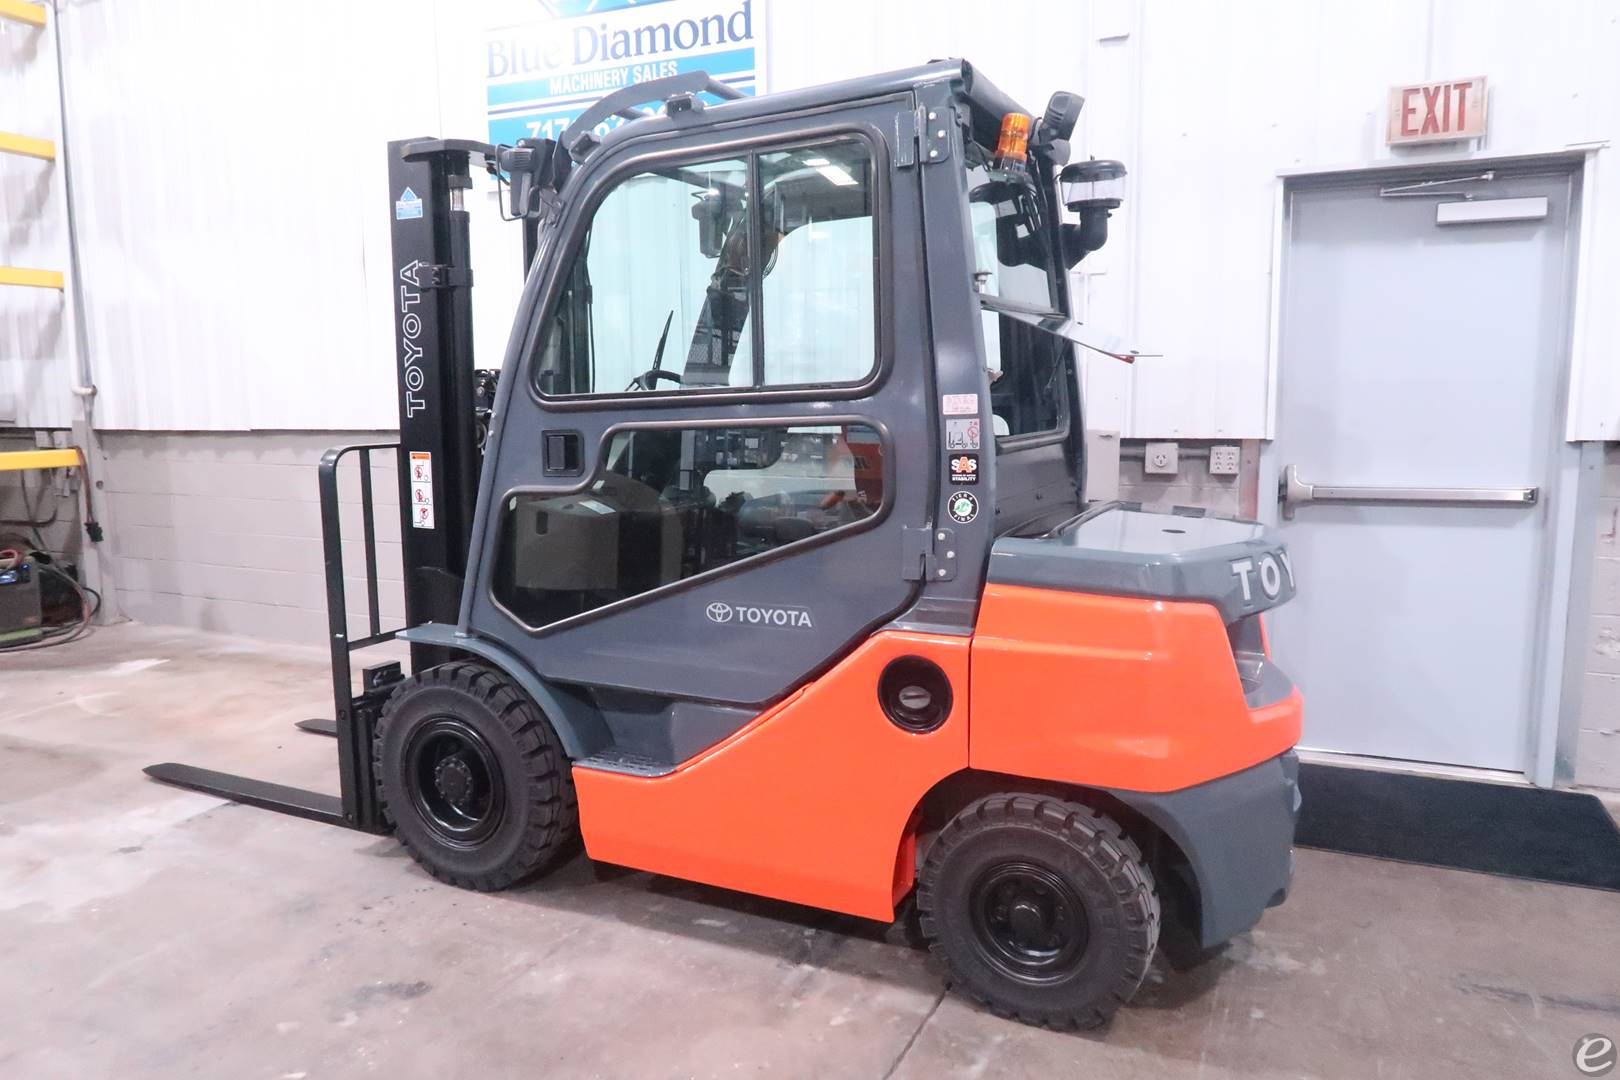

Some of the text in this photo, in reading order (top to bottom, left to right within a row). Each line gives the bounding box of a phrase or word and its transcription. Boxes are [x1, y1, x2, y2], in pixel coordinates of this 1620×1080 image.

[486, 0, 754, 79] Blue Diamond
[550, 60, 678, 96] MACHINERY SALES
[1401, 82, 1472, 137] EXIT
[400, 259, 425, 418] TOYOTA
[951, 456, 977, 473] SAS
[735, 606, 812, 628] TOYOTA
